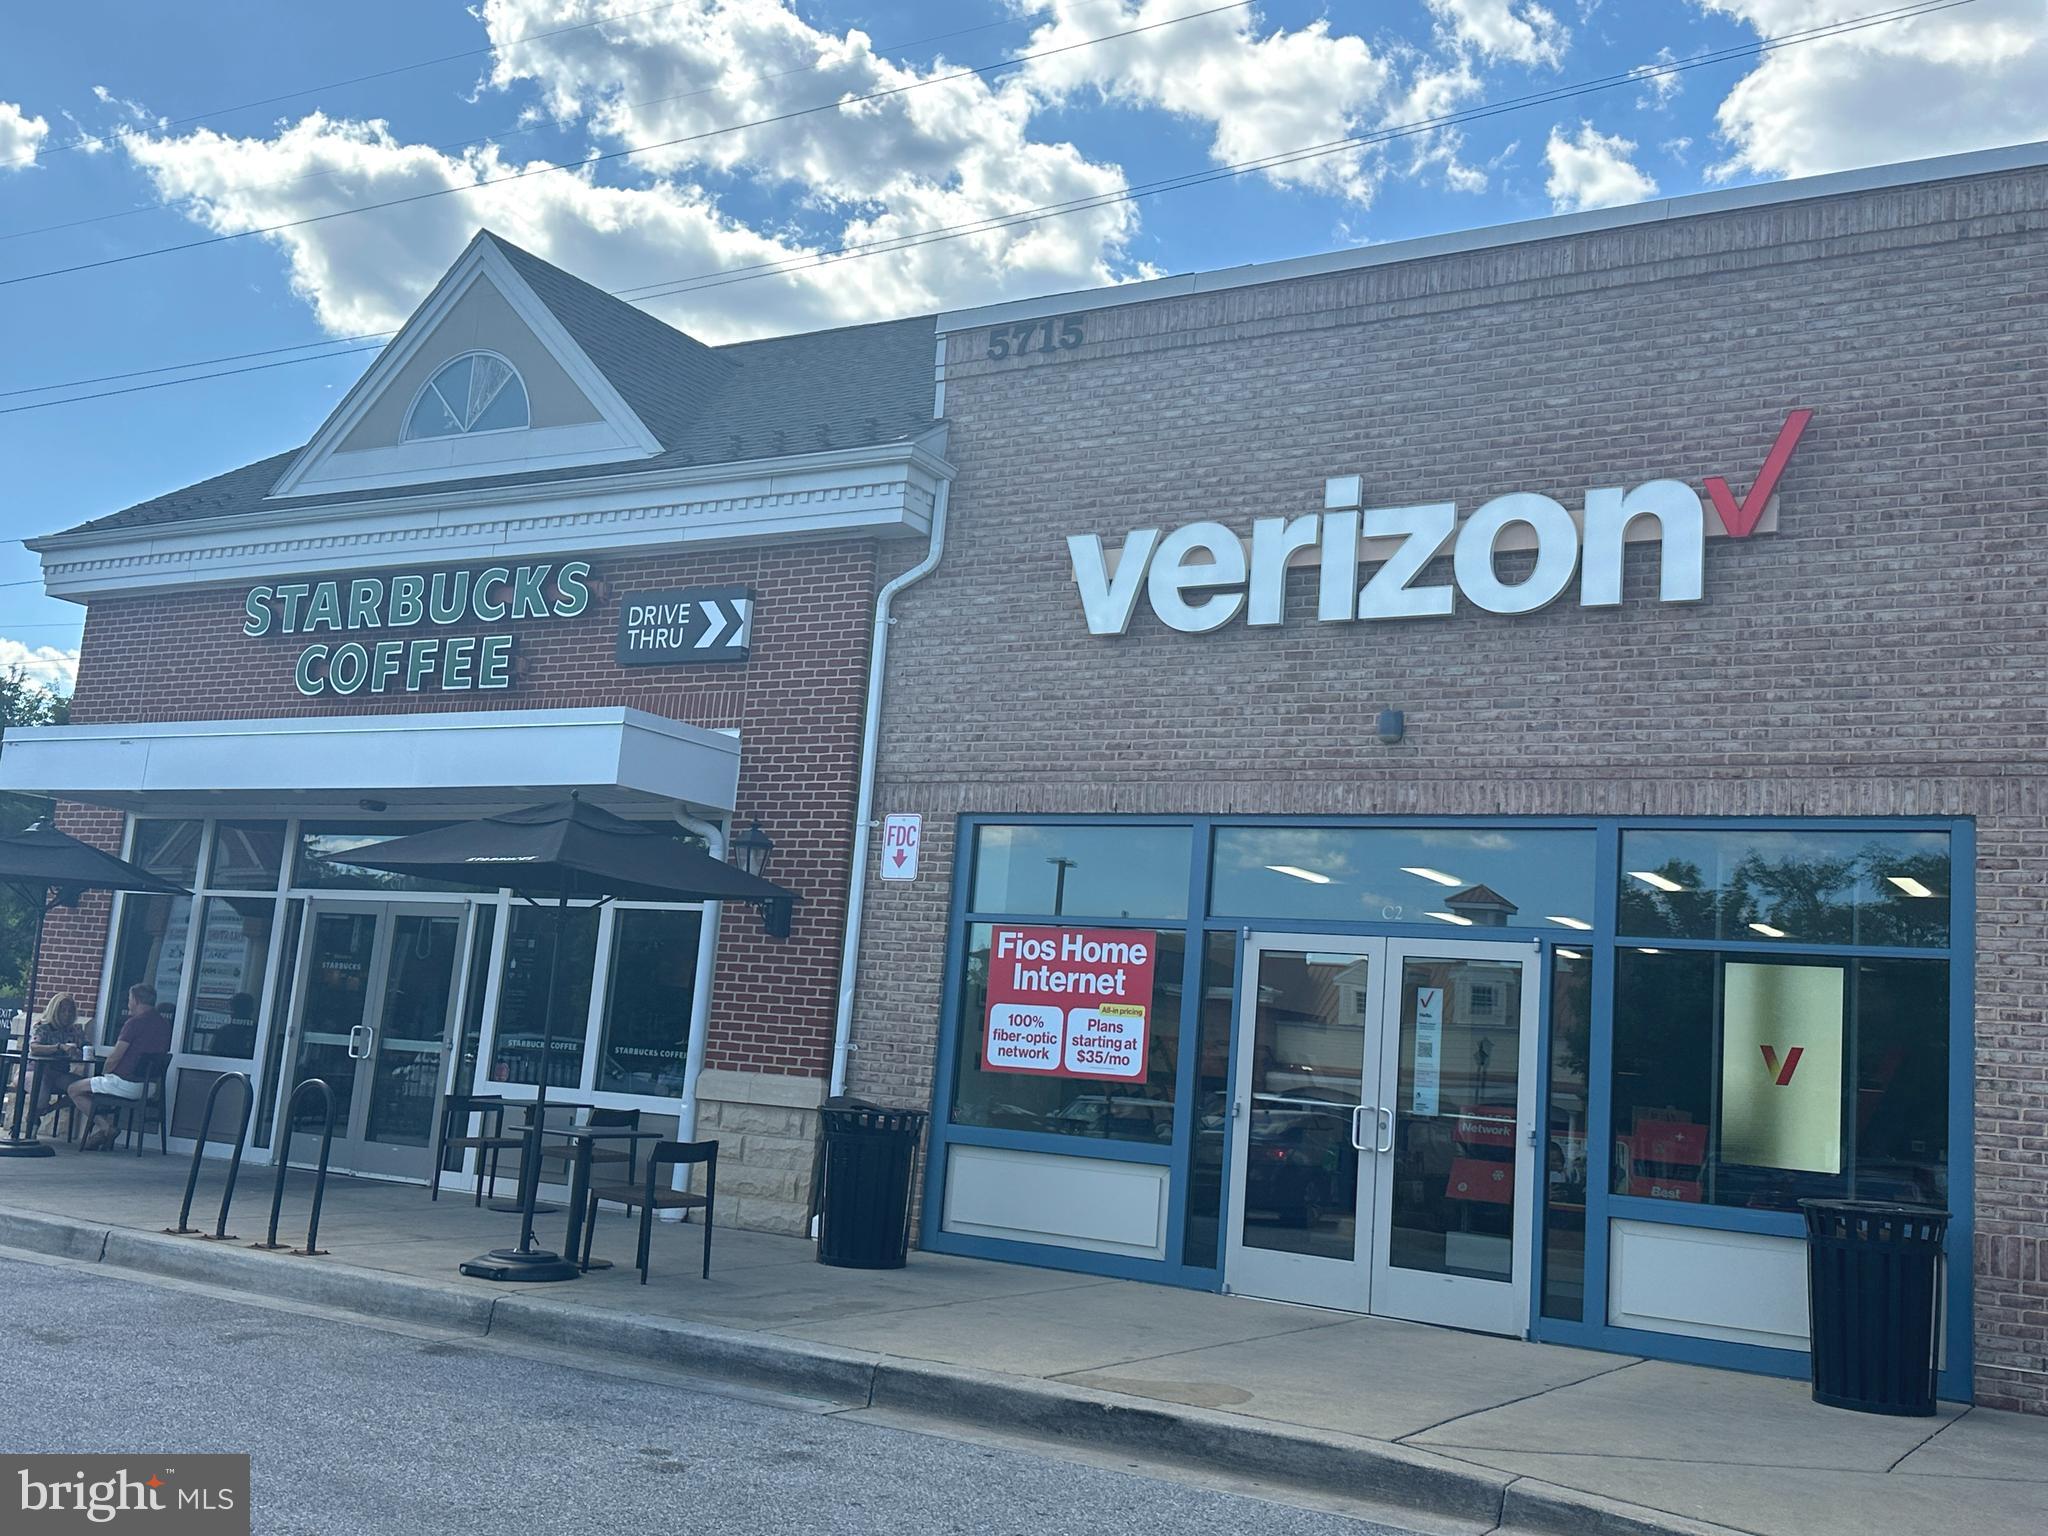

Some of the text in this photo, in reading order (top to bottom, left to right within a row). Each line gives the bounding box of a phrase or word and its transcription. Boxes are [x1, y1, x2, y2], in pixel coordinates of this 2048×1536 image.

[987, 317, 1084, 360] 5715
[1066, 475, 1704, 636] verizon
[243, 561, 590, 636] STARBUCKS
[629, 603, 691, 626] DRIVE
[628, 627, 684, 650] THRU
[295, 635, 512, 696] COFFEE
[887, 825, 917, 847] FDC
[1382, 905, 1402, 920] C2
[998, 932, 1148, 966] Fios Home
[322, 961, 361, 970] STARBUCKS
[1013, 963, 1126, 996] Internet
[1101, 1006, 1143, 1017] All-in pricing
[1008, 1014, 1045, 1028] 100%
[1087, 1018, 1124, 1033] Plans
[508, 1039, 577, 1051] STARBUCK COFFEE
[993, 1029, 1058, 1046] fiber-optic
[1072, 1035, 1138, 1052] starting at
[615, 1046, 658, 1057] STARBUCKS
[998, 1046, 1050, 1060] network
[1076, 1050, 1130, 1066] $35/mo
[1462, 1122, 1511, 1136] Network
[1651, 1186, 1681, 1200] Best
